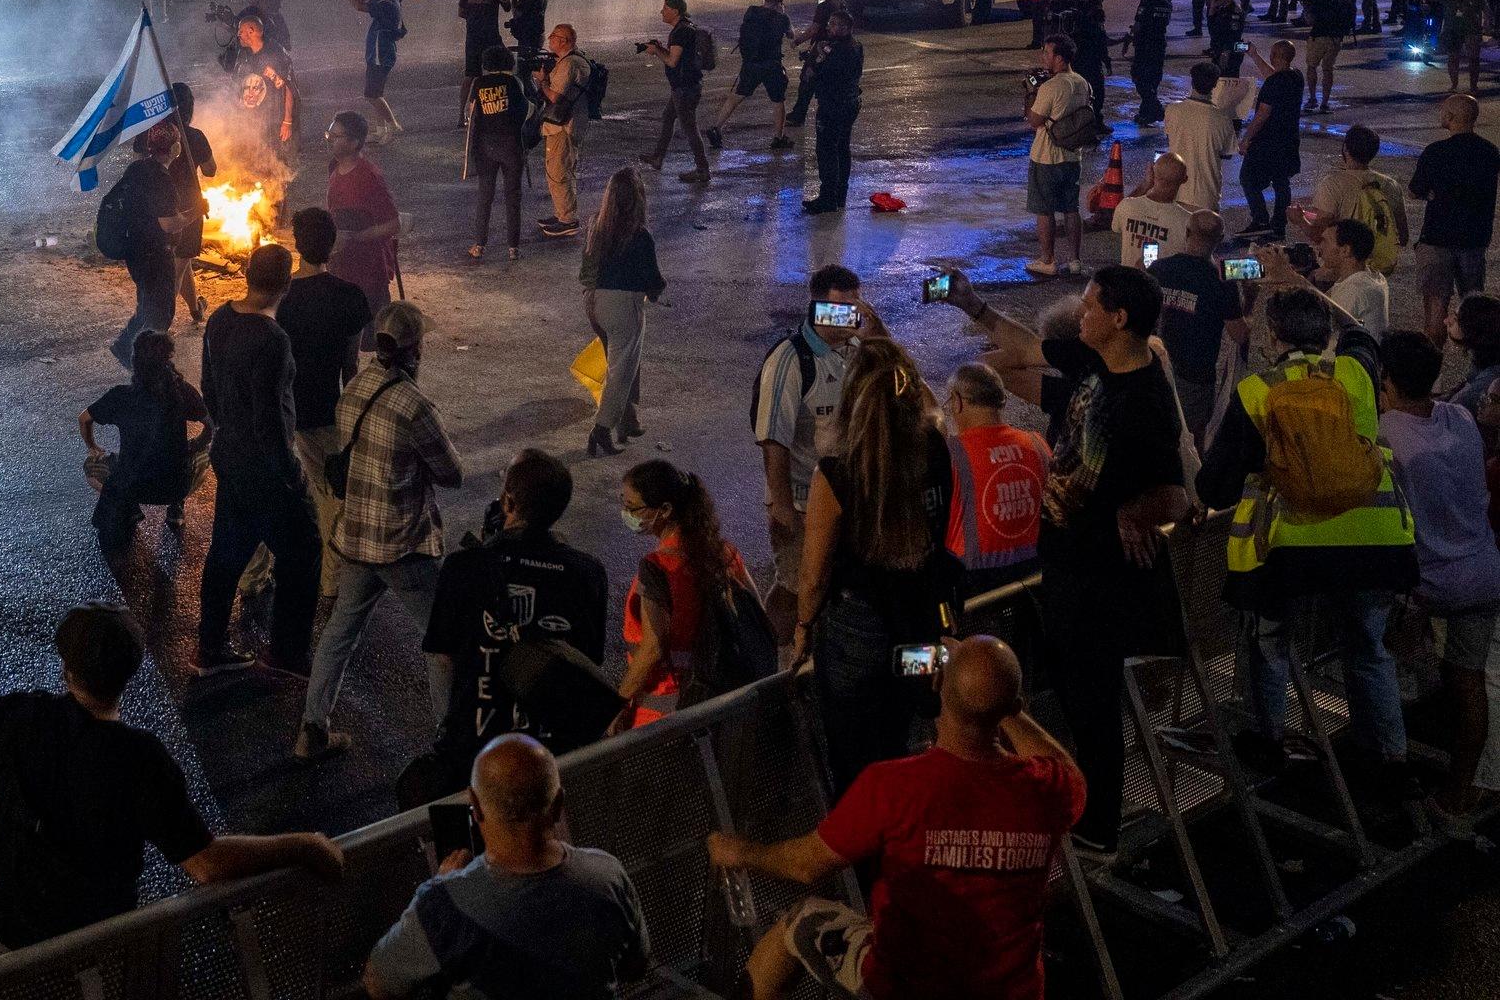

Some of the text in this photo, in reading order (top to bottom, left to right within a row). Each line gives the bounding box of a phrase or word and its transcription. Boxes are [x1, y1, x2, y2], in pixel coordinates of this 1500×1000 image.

[140, 94, 166, 109] חופשי
[1126, 218, 1169, 242] בחירות
[996, 478, 1031, 502] צוות
[993, 498, 1036, 520] רפואי
[925, 830, 1051, 849] HOSTAGES AND MISSING
[924, 845, 1047, 870] FAMILIES FORUM
